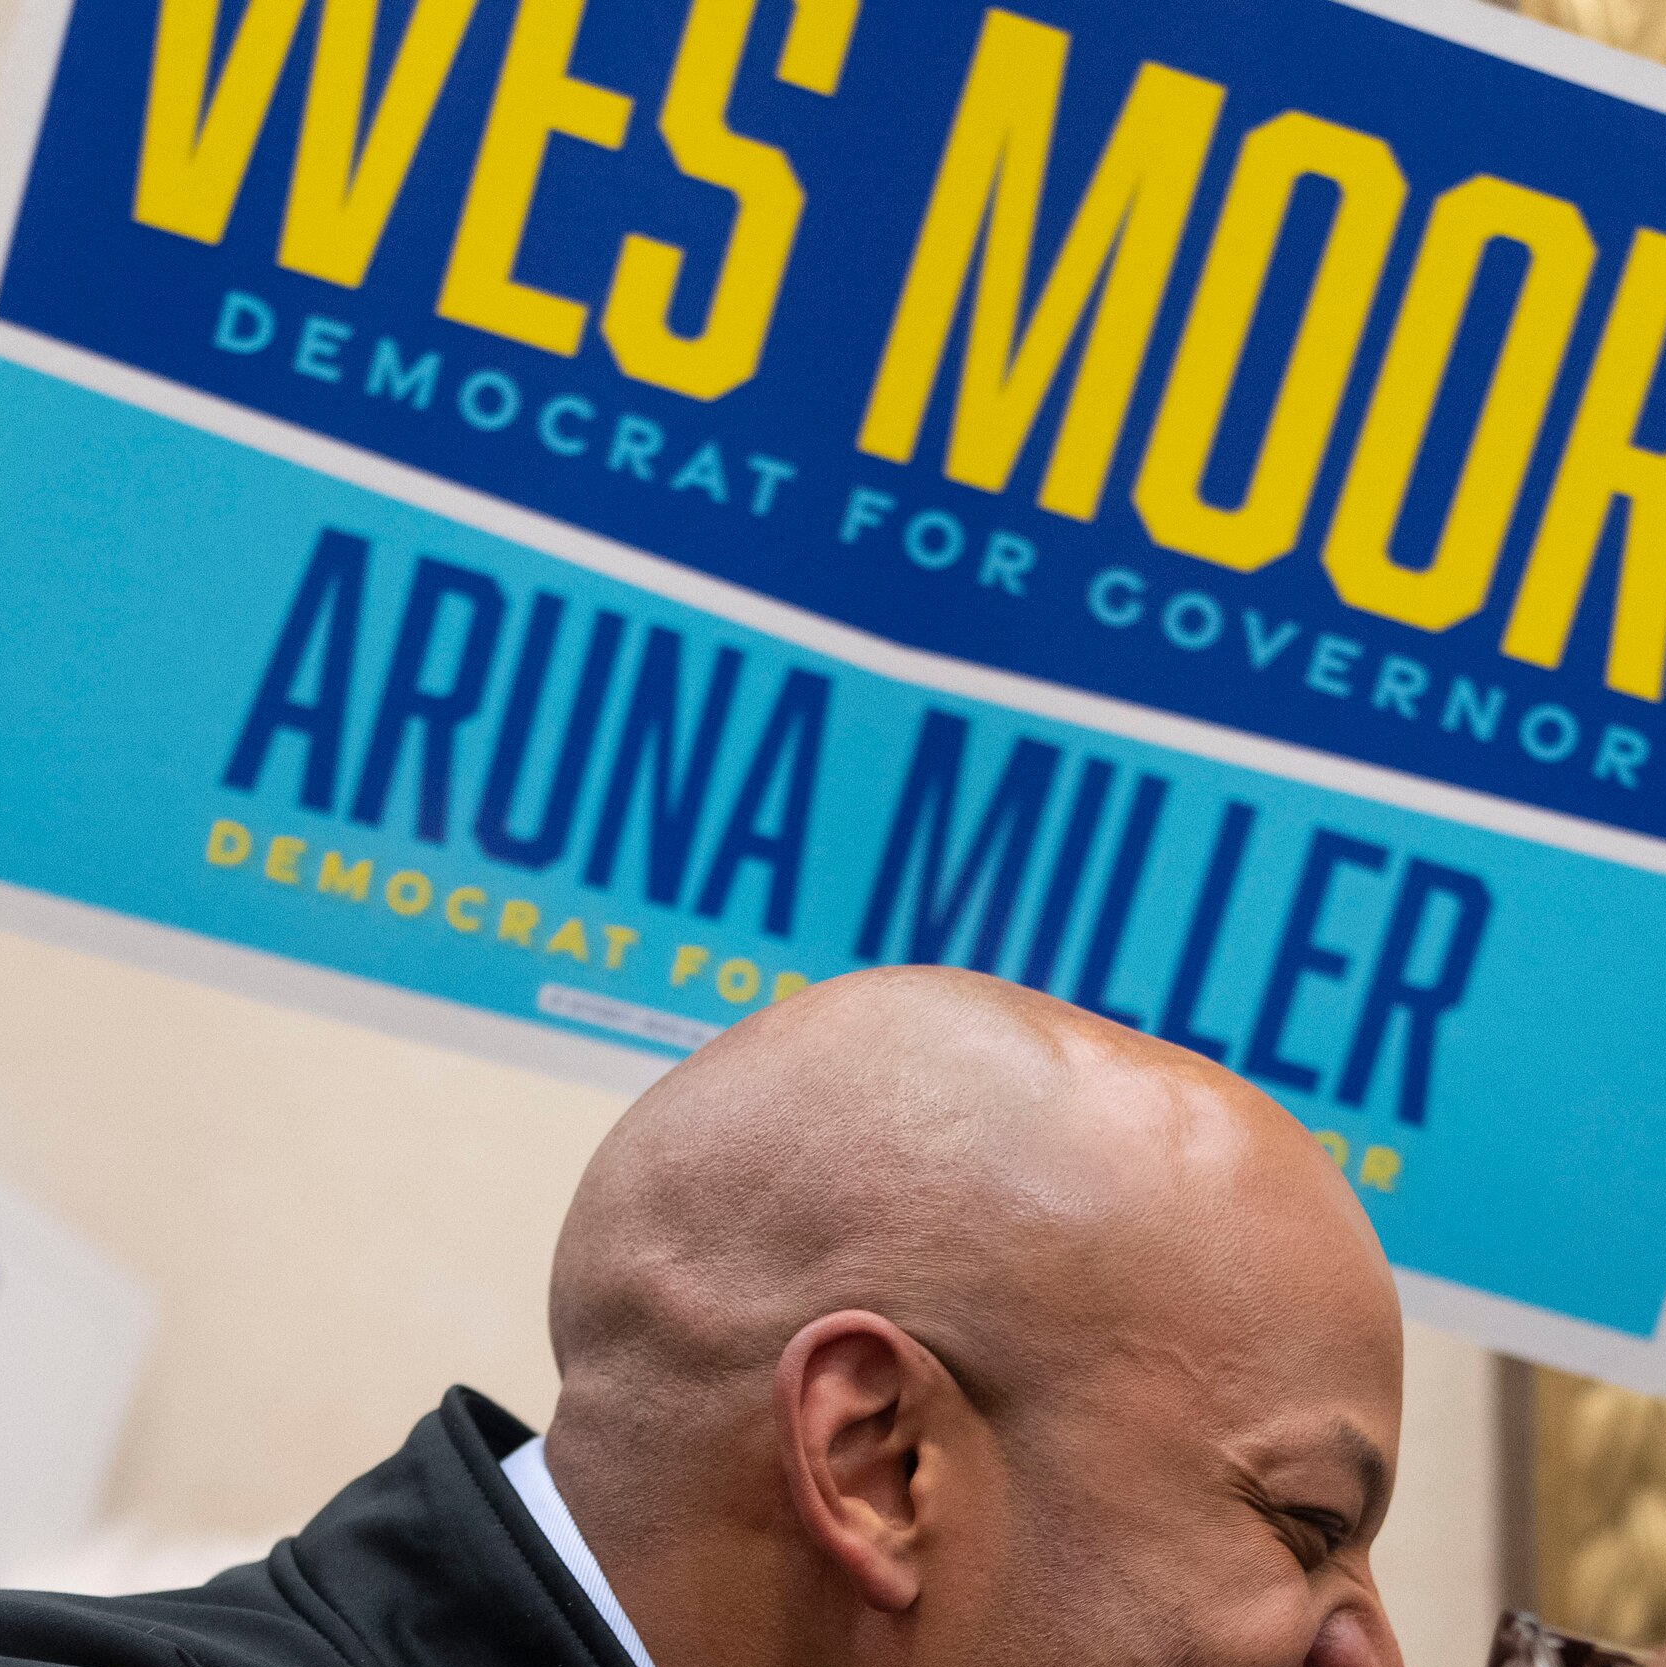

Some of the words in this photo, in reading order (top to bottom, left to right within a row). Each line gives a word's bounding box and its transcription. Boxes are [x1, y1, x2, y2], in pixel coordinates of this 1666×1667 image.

[132, 0, 863, 402] WES
[212, 291, 797, 515] DEMOCRAT
[839, 485, 1037, 595] FOR
[1088, 569, 1652, 788] GOVERNOR
[206, 820, 638, 968] DEMOCRAT
[221, 526, 834, 942] ARUNA
[853, 708, 1496, 1127] MILLER
